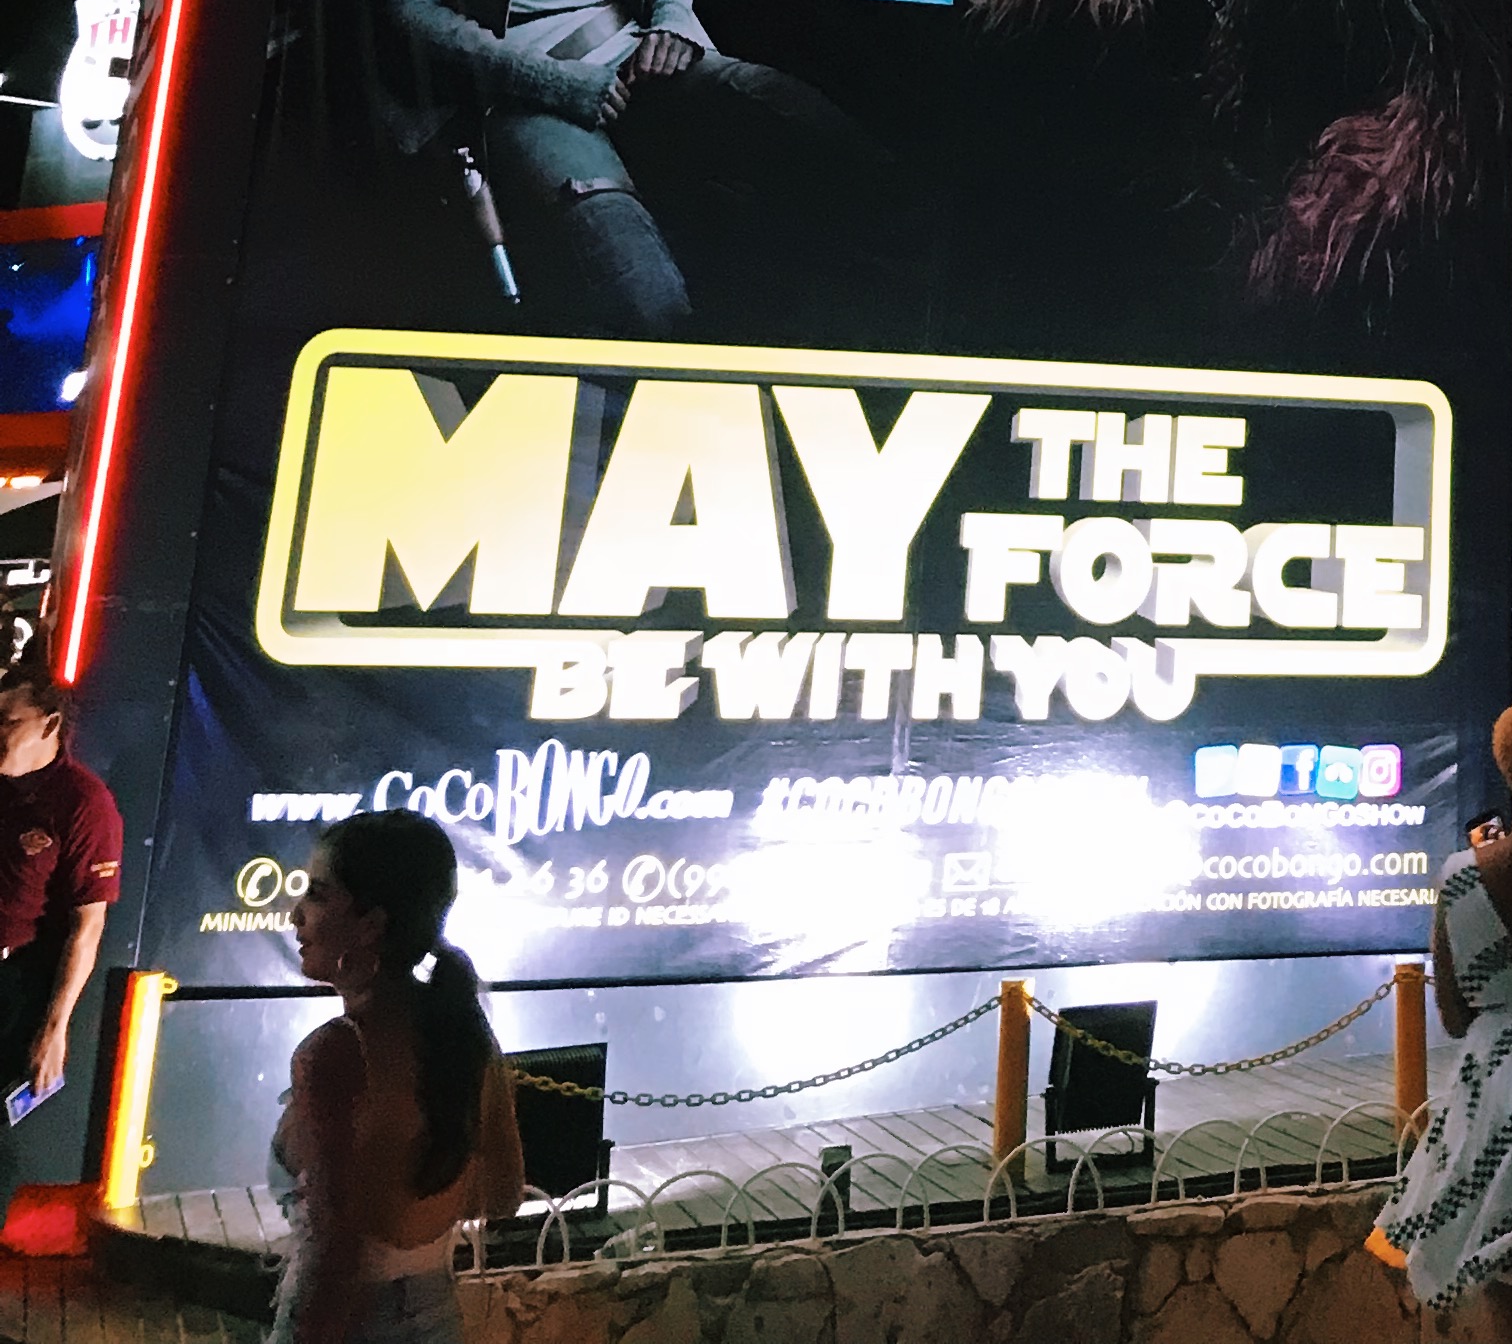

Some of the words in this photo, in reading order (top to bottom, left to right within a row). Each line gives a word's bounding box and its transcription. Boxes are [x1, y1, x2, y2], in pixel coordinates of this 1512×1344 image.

[293, 366, 992, 621] MAY
[1010, 407, 1246, 505] THE
[959, 514, 1424, 630] FORCE
[529, 630, 702, 720] BE
[700, 631, 986, 720] WITH
[988, 635, 1198, 721] YOU
[199, 912, 295, 932] MINIMU
[565, 859, 608, 900] 36
[1206, 892, 1242, 910] CON
[1247, 887, 1353, 910] FOTOGRAFÍA
